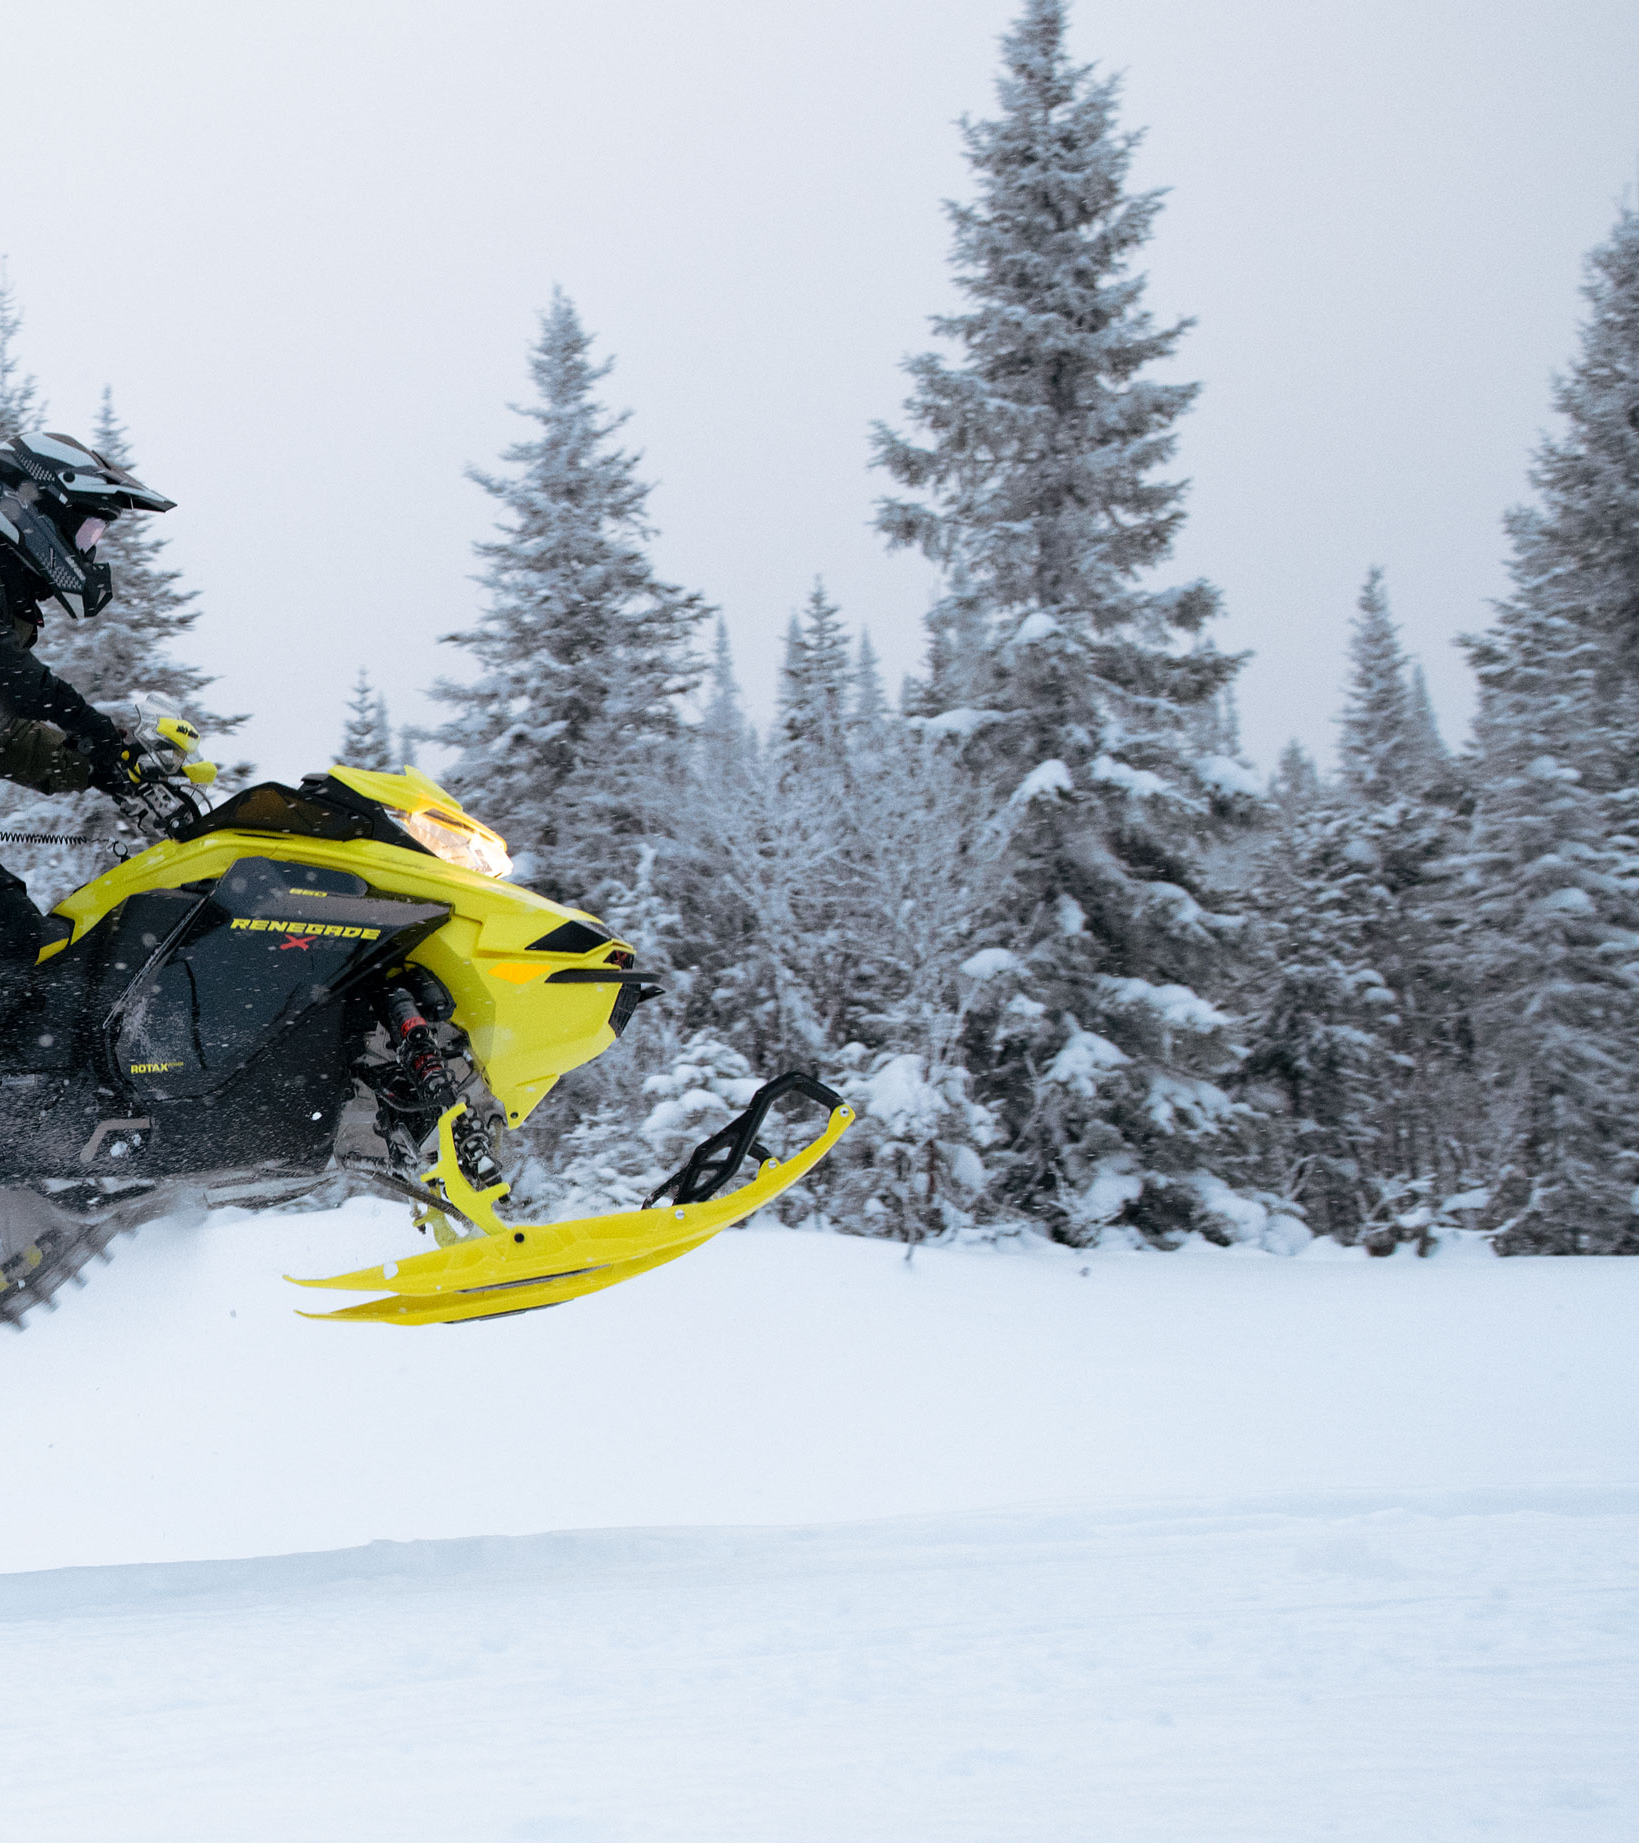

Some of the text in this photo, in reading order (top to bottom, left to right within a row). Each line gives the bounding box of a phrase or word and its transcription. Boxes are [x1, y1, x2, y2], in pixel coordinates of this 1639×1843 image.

[230, 918, 381, 940] RENEGADE
[279, 934, 318, 951] X
[130, 1063, 169, 1074] ROTAX
